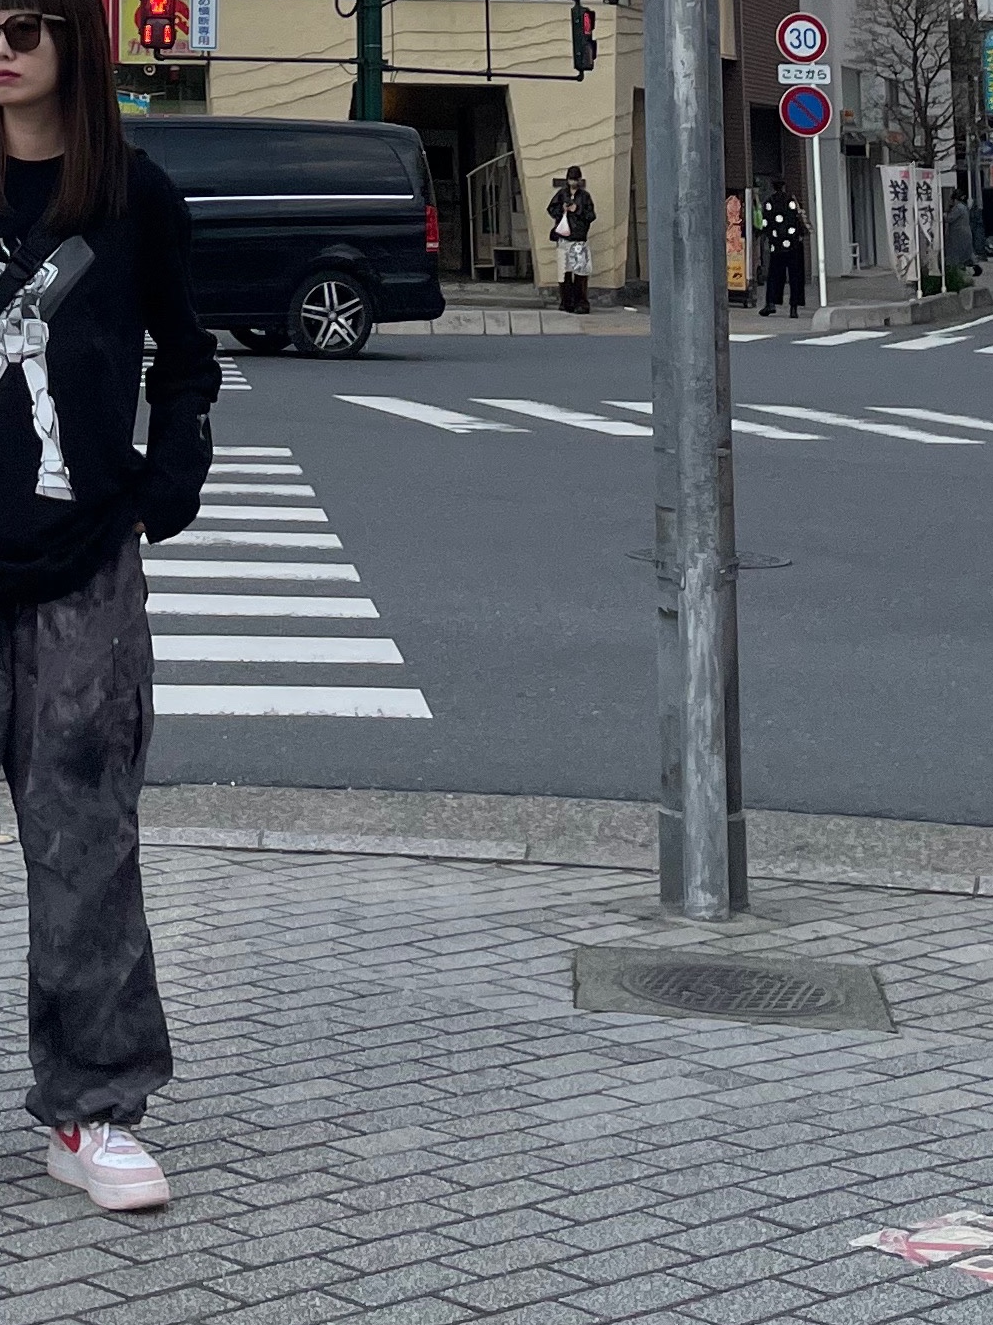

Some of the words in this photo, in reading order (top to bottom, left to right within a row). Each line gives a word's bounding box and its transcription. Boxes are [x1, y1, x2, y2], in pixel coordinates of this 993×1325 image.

[788, 27, 818, 50] 30
[781, 66, 828, 81] ここから
